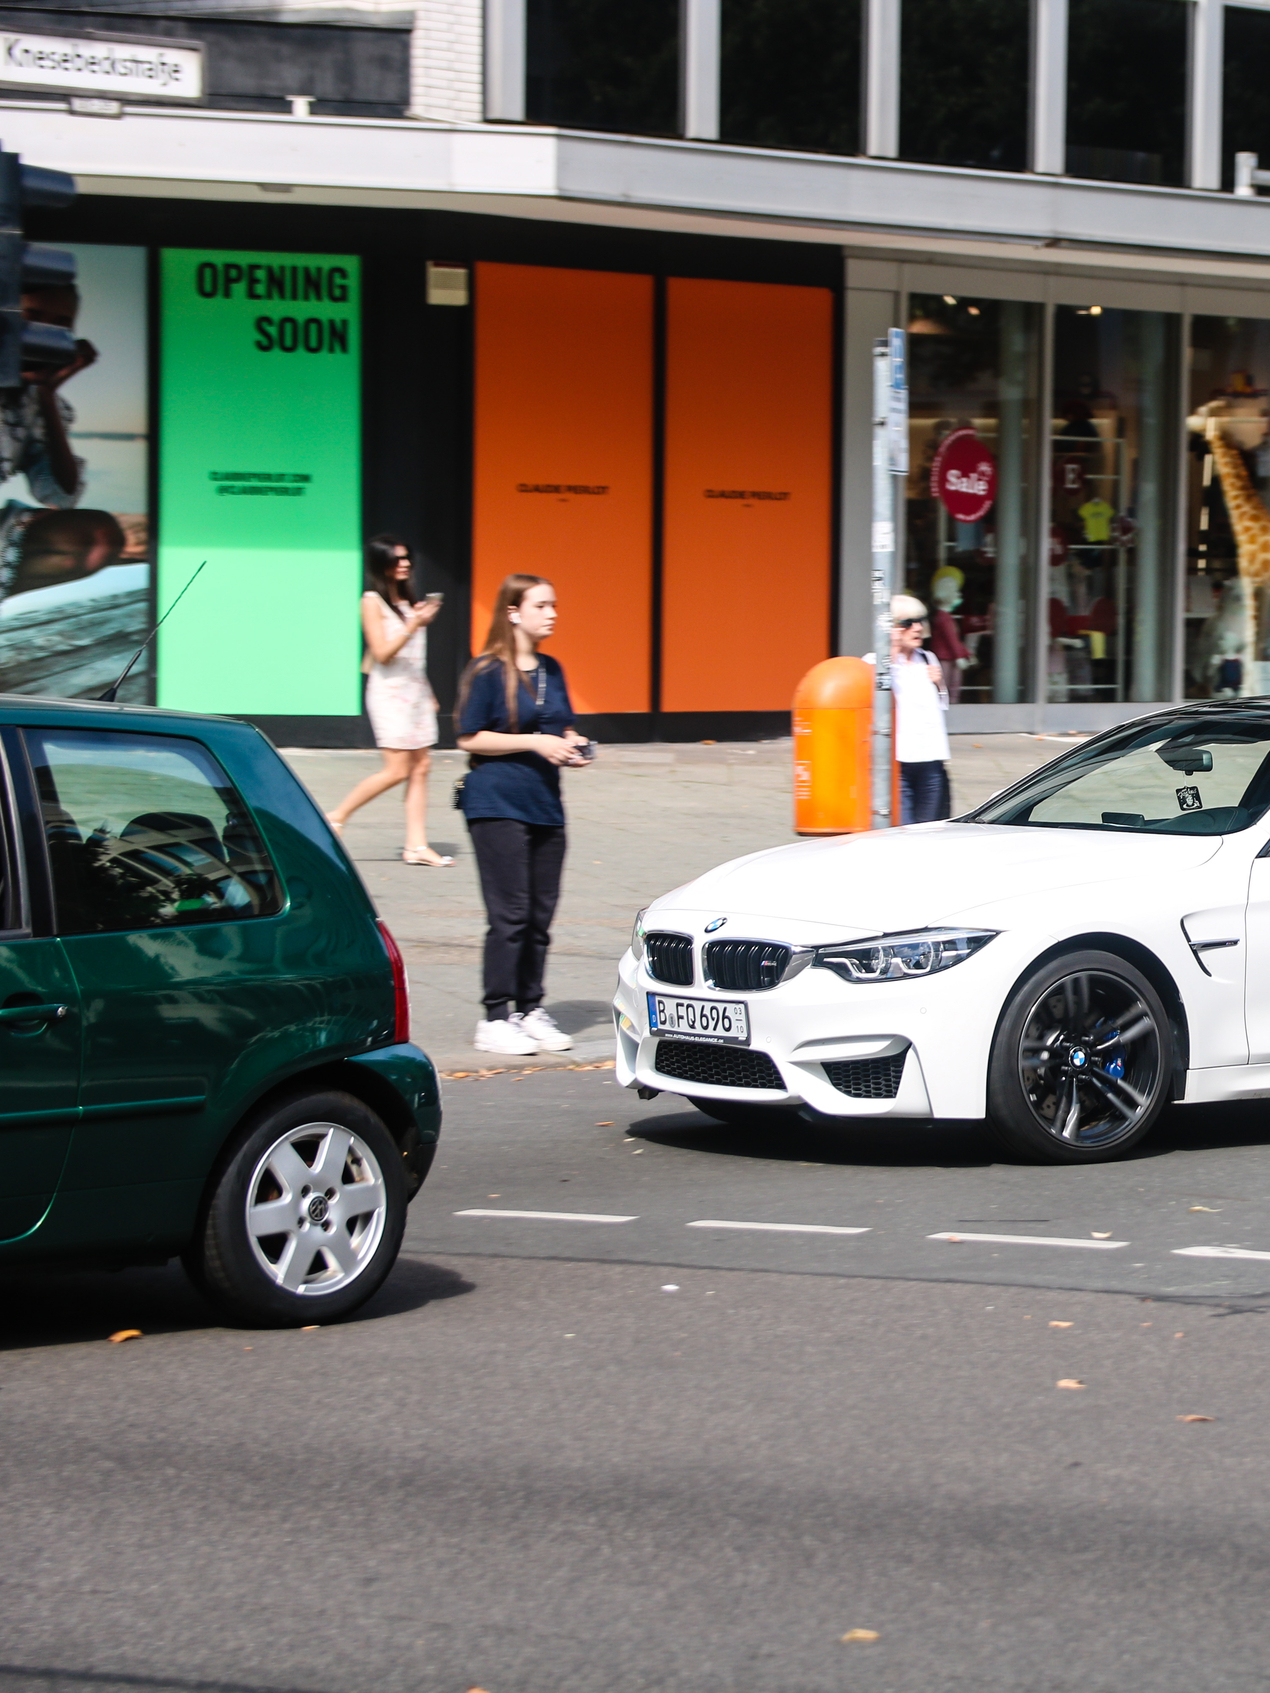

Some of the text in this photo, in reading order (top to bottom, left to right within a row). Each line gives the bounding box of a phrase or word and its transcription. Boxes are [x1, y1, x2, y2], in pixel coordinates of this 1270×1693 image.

[196, 262, 349, 303] OPENING
[254, 316, 349, 354] SOON
[945, 469, 989, 495] Sale
[657, 999, 667, 1026] B
